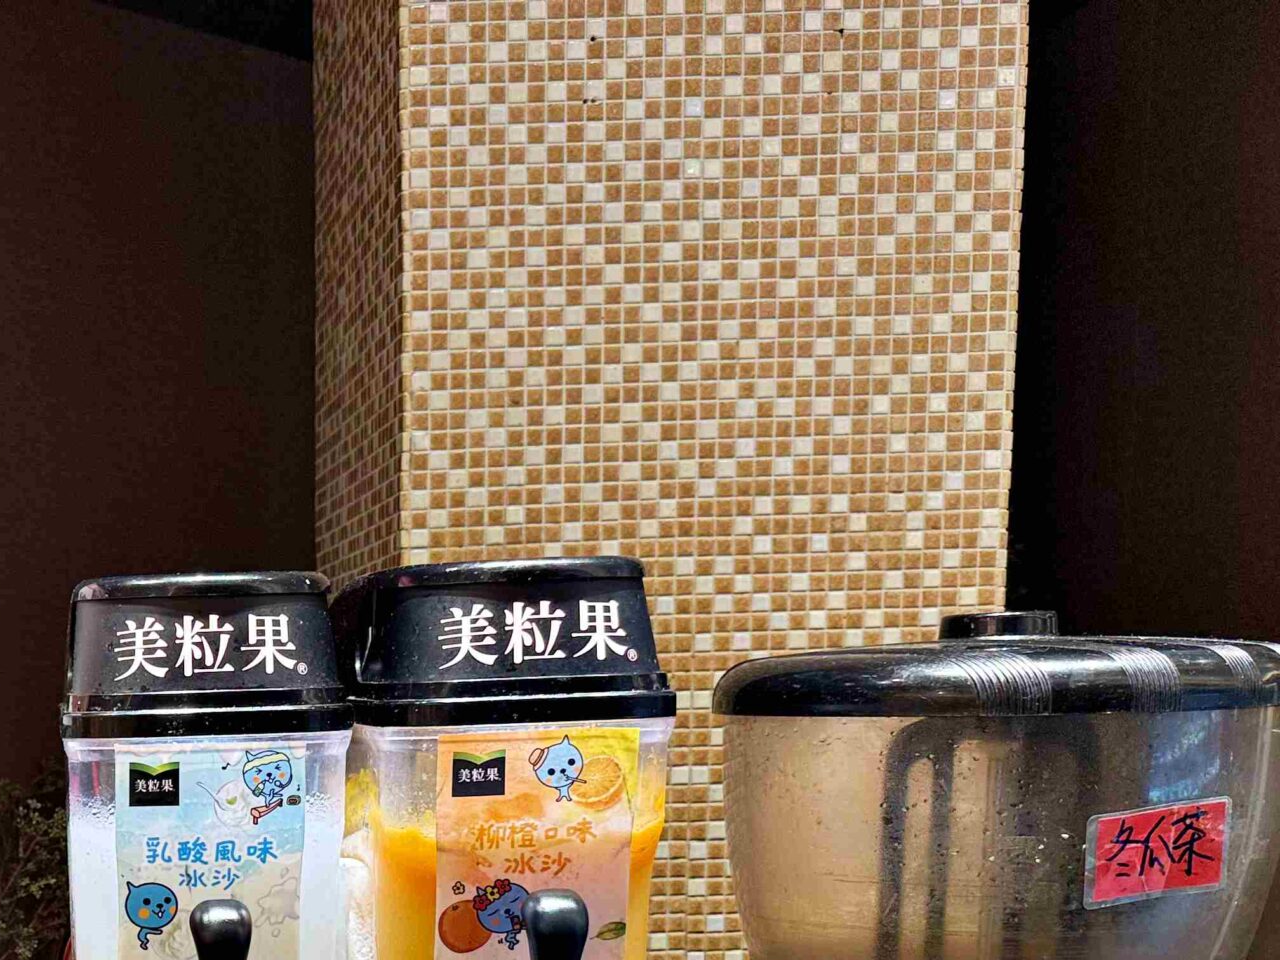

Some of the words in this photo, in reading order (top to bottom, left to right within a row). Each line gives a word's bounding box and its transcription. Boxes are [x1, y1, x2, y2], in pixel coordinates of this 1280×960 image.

[113, 612, 297, 682] 美粒果
[437, 600, 628, 669] 美粒果
[134, 778, 174, 793] 美粒果
[458, 767, 500, 783] 美粒果
[475, 818, 597, 850] 柳橙口味
[1105, 807, 1216, 876] 冬瓜茶
[146, 837, 278, 865] 乳酸風味
[504, 852, 572, 876] 冰沙
[179, 867, 240, 890] 冰沙
